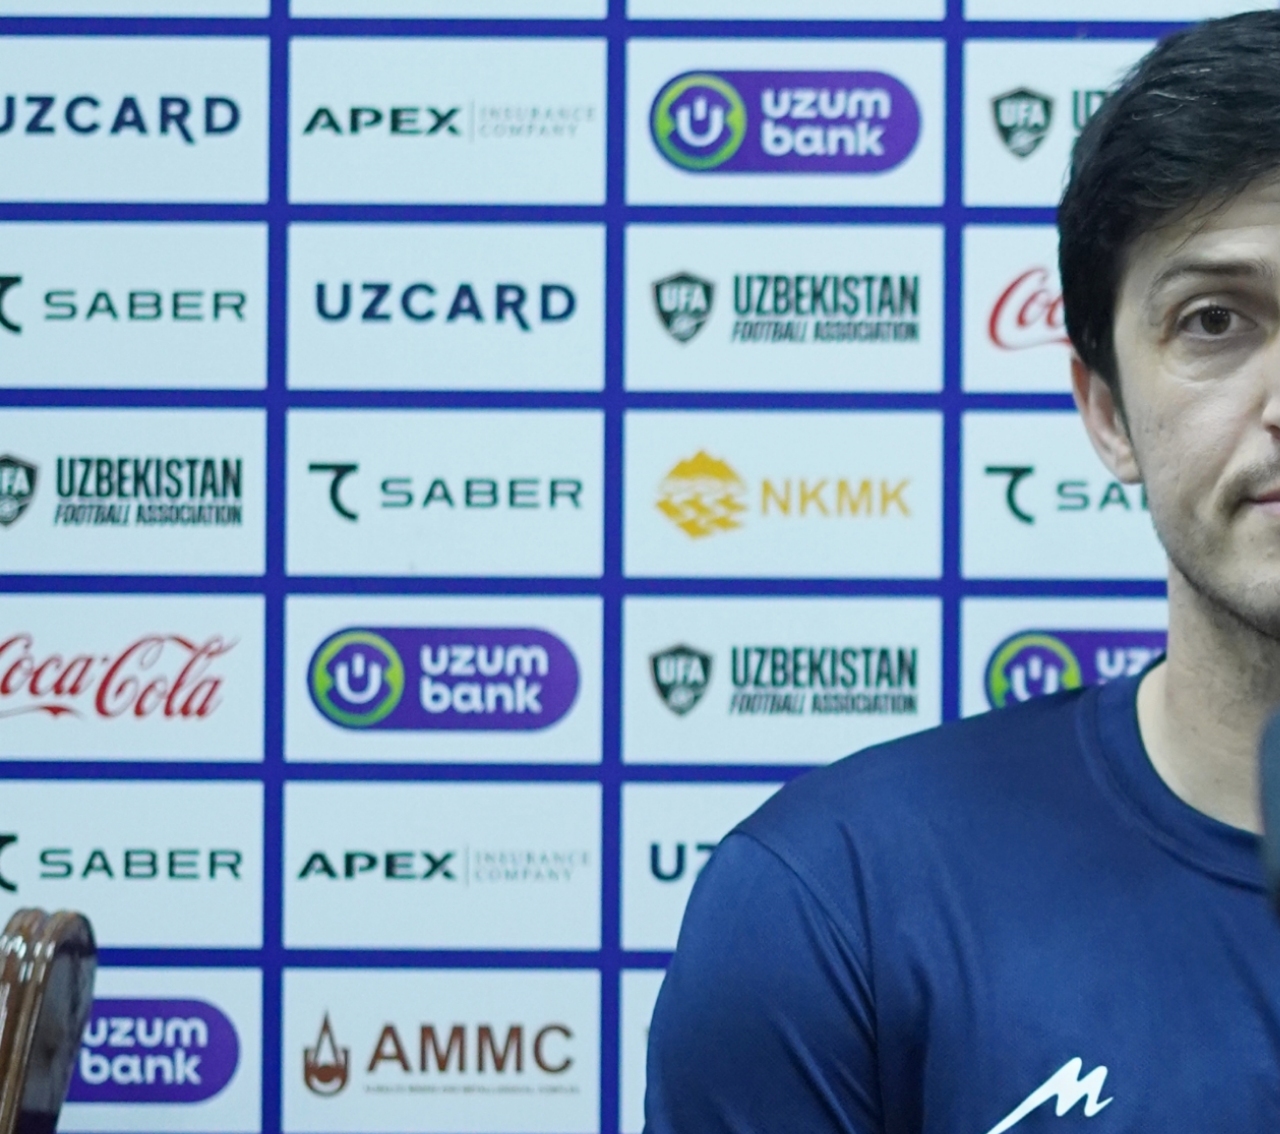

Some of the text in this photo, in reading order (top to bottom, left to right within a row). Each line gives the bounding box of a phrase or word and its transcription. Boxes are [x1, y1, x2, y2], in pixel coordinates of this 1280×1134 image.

[303, 106, 461, 136] APEX
[761, 88, 892, 120] uzum
[761, 122, 886, 157] bank
[43, 290, 247, 321] SABER
[315, 281, 577, 332] UZCARD
[733, 275, 919, 316] UZBEKISTAN
[56, 457, 243, 498] UZBEKISTAN
[380, 477, 583, 509] SABER
[54, 503, 243, 526] FOOTBALL ASSOCIATION
[760, 478, 910, 516] NKMK
[0, 633, 241, 719] oca-Cola
[419, 644, 550, 676] uzum
[731, 646, 918, 688] UZBEKISTAN
[420, 677, 543, 714] bank
[729, 693, 806, 716] FOOTBALL
[39, 848, 243, 880] SABER
[297, 851, 457, 880] APEX
[366, 1024, 574, 1074] AMMC
[79, 1049, 203, 1085] bank
